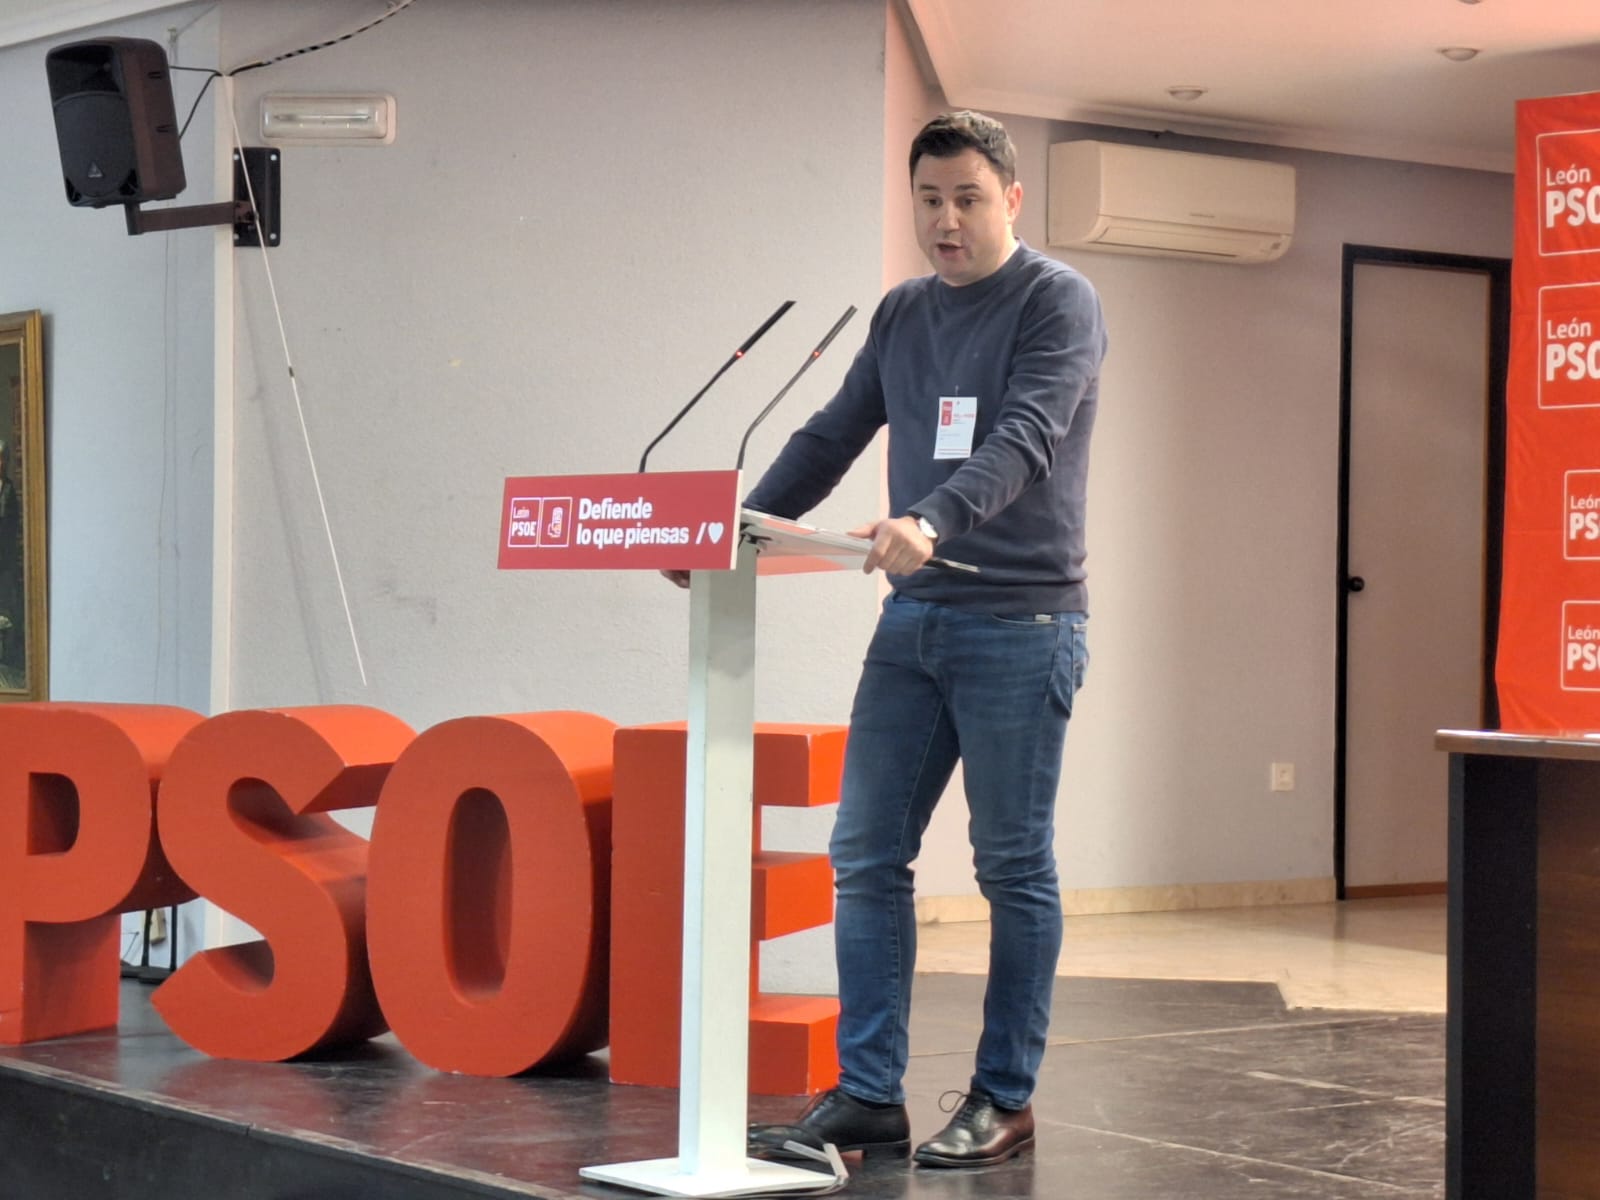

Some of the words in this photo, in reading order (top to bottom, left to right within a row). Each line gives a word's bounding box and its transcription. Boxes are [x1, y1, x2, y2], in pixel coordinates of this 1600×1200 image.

[1546, 163, 1591, 186] León
[1547, 316, 1592, 340] León
[578, 496, 653, 520] Defiende
[511, 521, 537, 537] PSOE
[576, 522, 592, 545] lo
[593, 527, 624, 549] que
[624, 522, 689, 549] piensas
[1570, 511, 1600, 540] PS
[1568, 624, 1600, 641] León
[1567, 642, 1600, 671] PS
[0, 703, 842, 1096] PSOE
